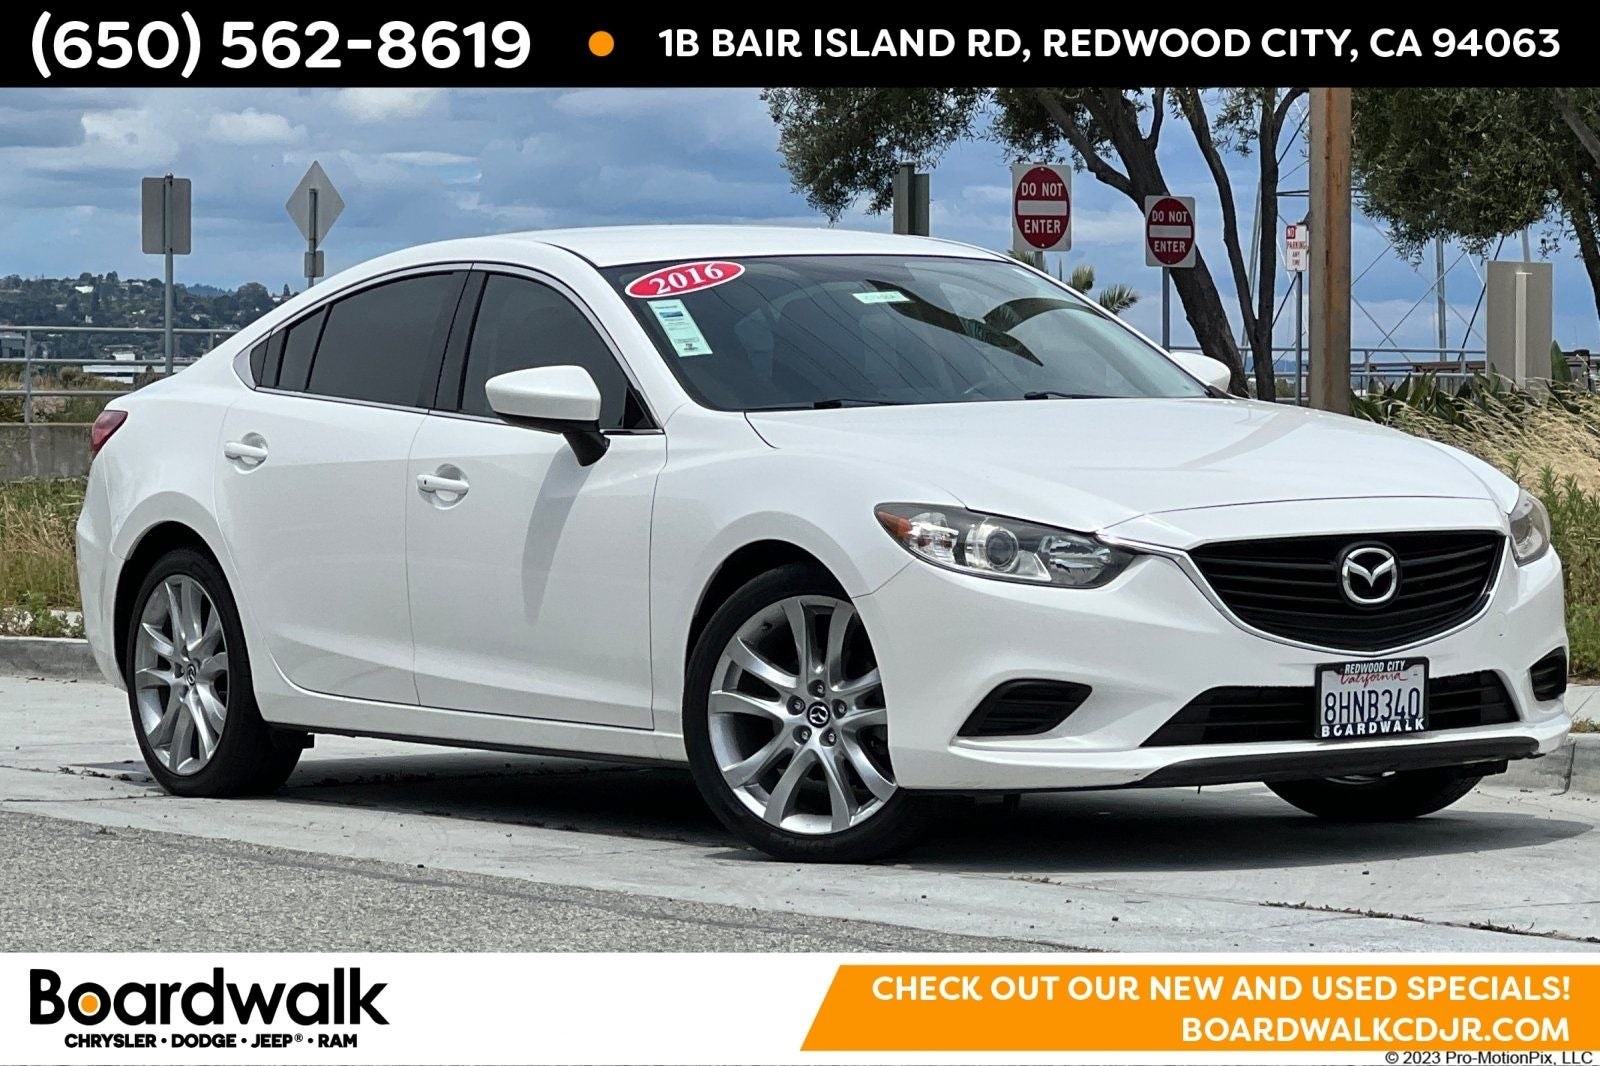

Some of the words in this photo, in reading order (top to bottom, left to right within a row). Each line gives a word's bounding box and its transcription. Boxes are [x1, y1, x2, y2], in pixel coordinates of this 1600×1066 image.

[1021, 182, 1036, 197] DO
[1041, 182, 1063, 197] NOT
[1152, 210, 1165, 222] DO
[1168, 209, 1188, 222] NOT
[1024, 219, 1061, 234] ENTER
[1154, 240, 1186, 253] ENTER
[648, 263, 723, 294] 2016
[1345, 662, 1384, 674] REDWOOD
[1387, 660, 1406, 671] CITY
[1341, 672, 1408, 688] California
[1324, 687, 1420, 724] 8HNB340
[1322, 718, 1424, 737] BOARDWALK
